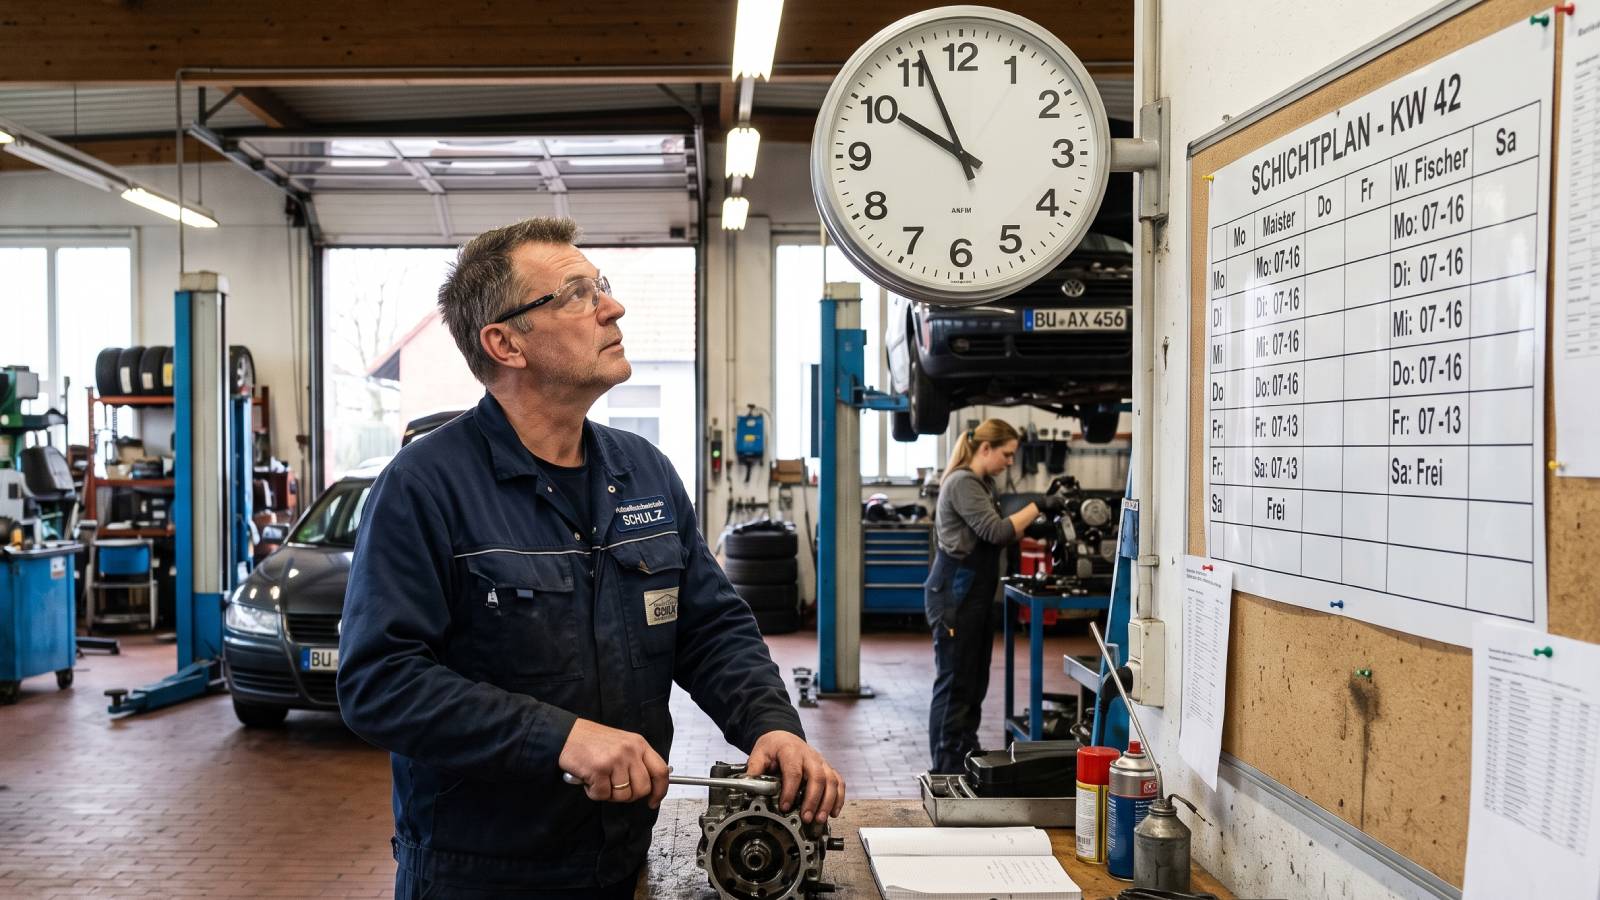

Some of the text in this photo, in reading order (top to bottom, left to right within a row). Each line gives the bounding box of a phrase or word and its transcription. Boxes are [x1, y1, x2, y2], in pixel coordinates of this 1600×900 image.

[942, 42, 979, 72] 12
[1004, 55, 1017, 84] 1
[898, 58, 925, 87] 11
[860, 95, 899, 124] 10
[1038, 90, 1060, 119] 2
[1251, 73, 1462, 196] SCHICHTPLAN - KW 42
[1496, 127, 1517, 156] Sa
[848, 142, 872, 171] 9
[1052, 139, 1075, 168] 3
[1394, 147, 1469, 192] W. Fischer
[1035, 188, 1060, 217] 4
[1361, 177, 1374, 203] Fr
[864, 191, 888, 220] 8
[1317, 195, 1332, 218] Do
[1394, 194, 1464, 240] Mo: 07-16
[1234, 227, 1246, 248] Mo
[1263, 210, 1296, 237] Maister
[903, 226, 924, 255] 7
[949, 238, 973, 267] 6
[999, 224, 1023, 254] 5
[1256, 245, 1300, 279] Mo: 07-16
[1393, 247, 1463, 288] Di: 07-16
[1213, 271, 1225, 291] Mo
[1256, 287, 1300, 318] Di: 07-16
[1093, 311, 1124, 327] 456
[1213, 308, 1222, 328] Di
[1393, 300, 1462, 337] Mi: 07-16
[1213, 344, 1223, 365] Mi
[1256, 329, 1299, 358] Mi: 07-16
[1393, 352, 1462, 386] Do: 07-16
[1212, 382, 1224, 401] Do
[1256, 372, 1299, 398] Do: 07-16
[1255, 414, 1298, 438] Fr: 07-13
[1392, 405, 1461, 435] Fr: 07-13
[1254, 456, 1298, 480] Sa: 07-13
[1392, 458, 1443, 486] Sa: Frei
[622, 509, 666, 526] SCHULZ
[1212, 493, 1222, 513] Sa
[1267, 497, 1285, 520] Frei
[311, 651, 331, 667] BU
